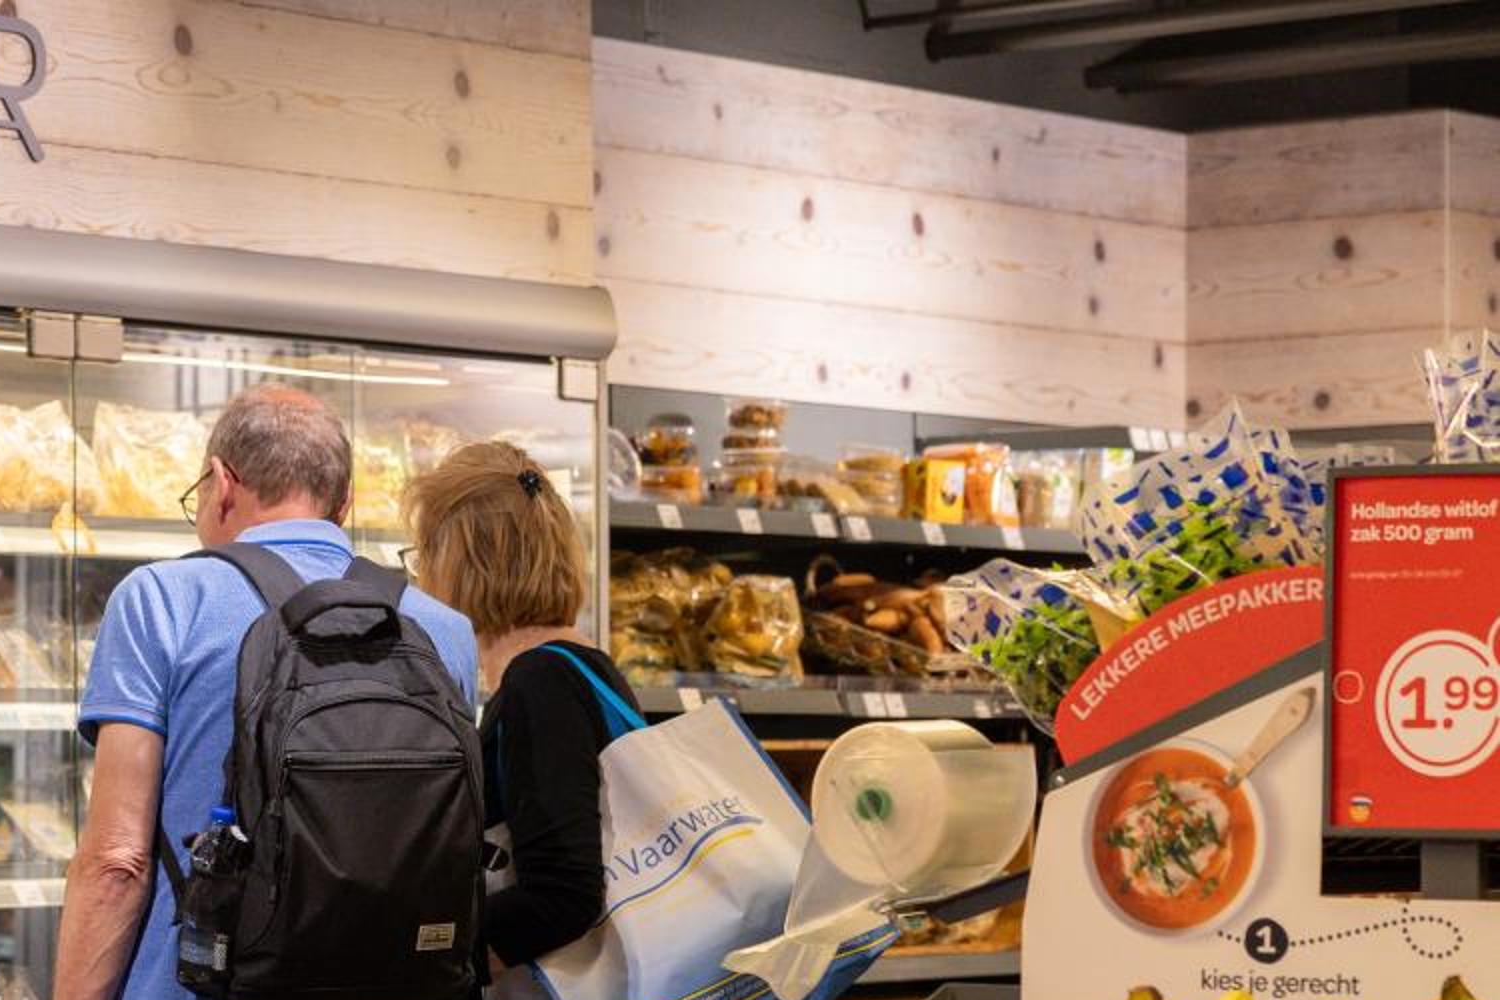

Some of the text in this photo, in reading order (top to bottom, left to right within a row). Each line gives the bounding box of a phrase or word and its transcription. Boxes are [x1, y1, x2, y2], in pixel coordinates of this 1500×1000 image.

[1351, 499, 1499, 519] Hollandse witlof
[1350, 524, 1475, 545] zak 500 gram
[1070, 578, 1324, 721] LEKKERE MEEPAKKER
[1400, 676, 1499, 729] 1.99
[1255, 925, 1277, 954] 1
[1201, 968, 1361, 999] kies je gerecht
